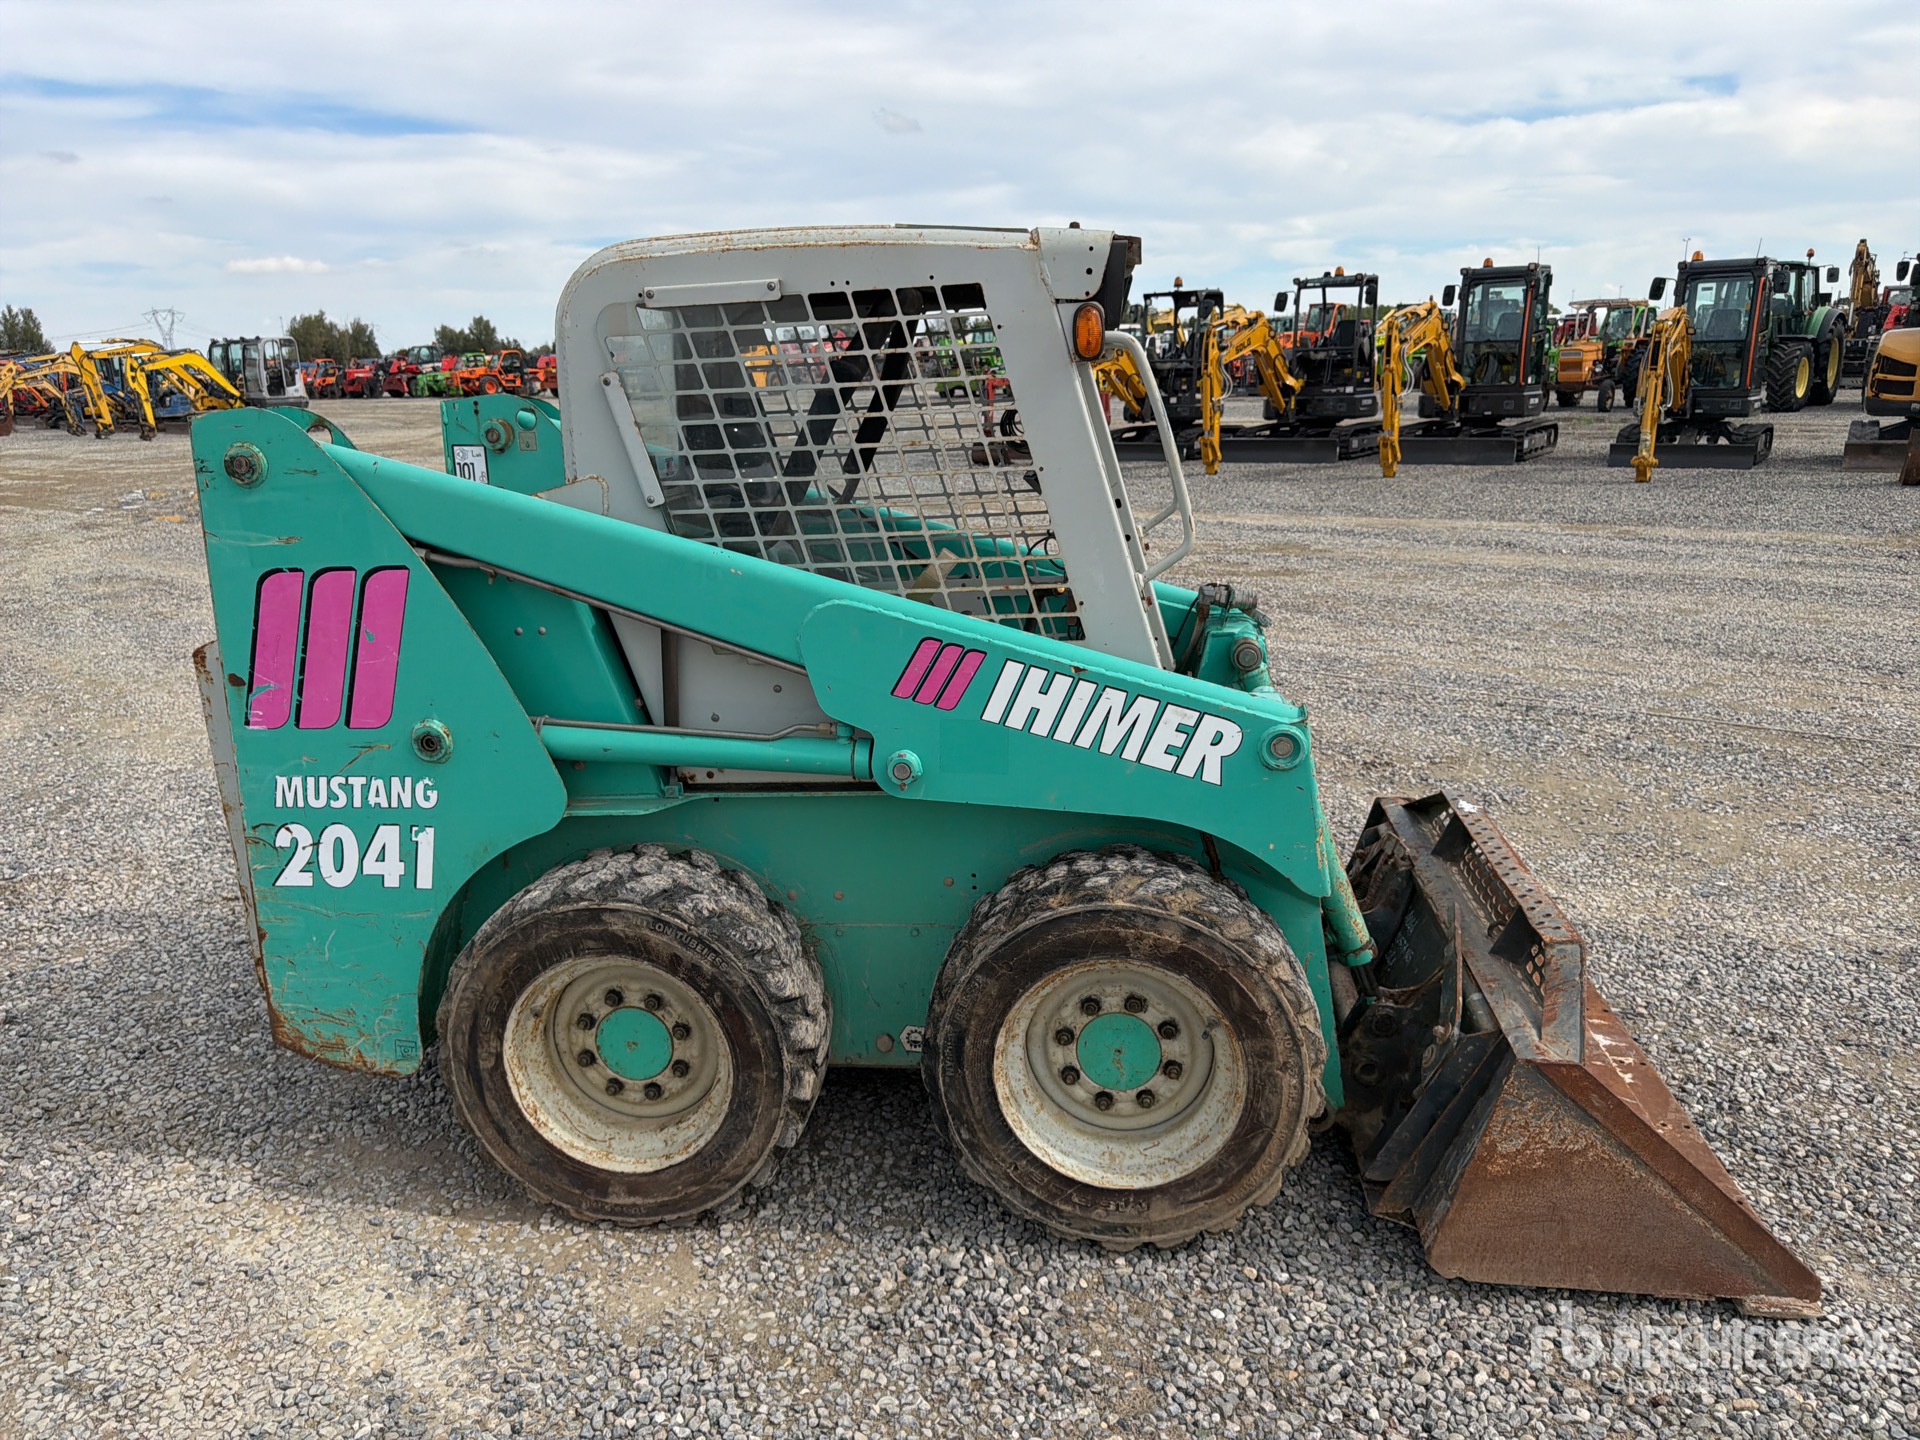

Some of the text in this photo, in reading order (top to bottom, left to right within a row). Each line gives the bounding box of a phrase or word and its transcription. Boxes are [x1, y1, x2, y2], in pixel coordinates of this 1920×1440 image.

[457, 462, 476, 481] 101
[980, 657, 1244, 787] IHIMER
[275, 775, 438, 809] MUSTANG
[273, 822, 436, 889] 2041
